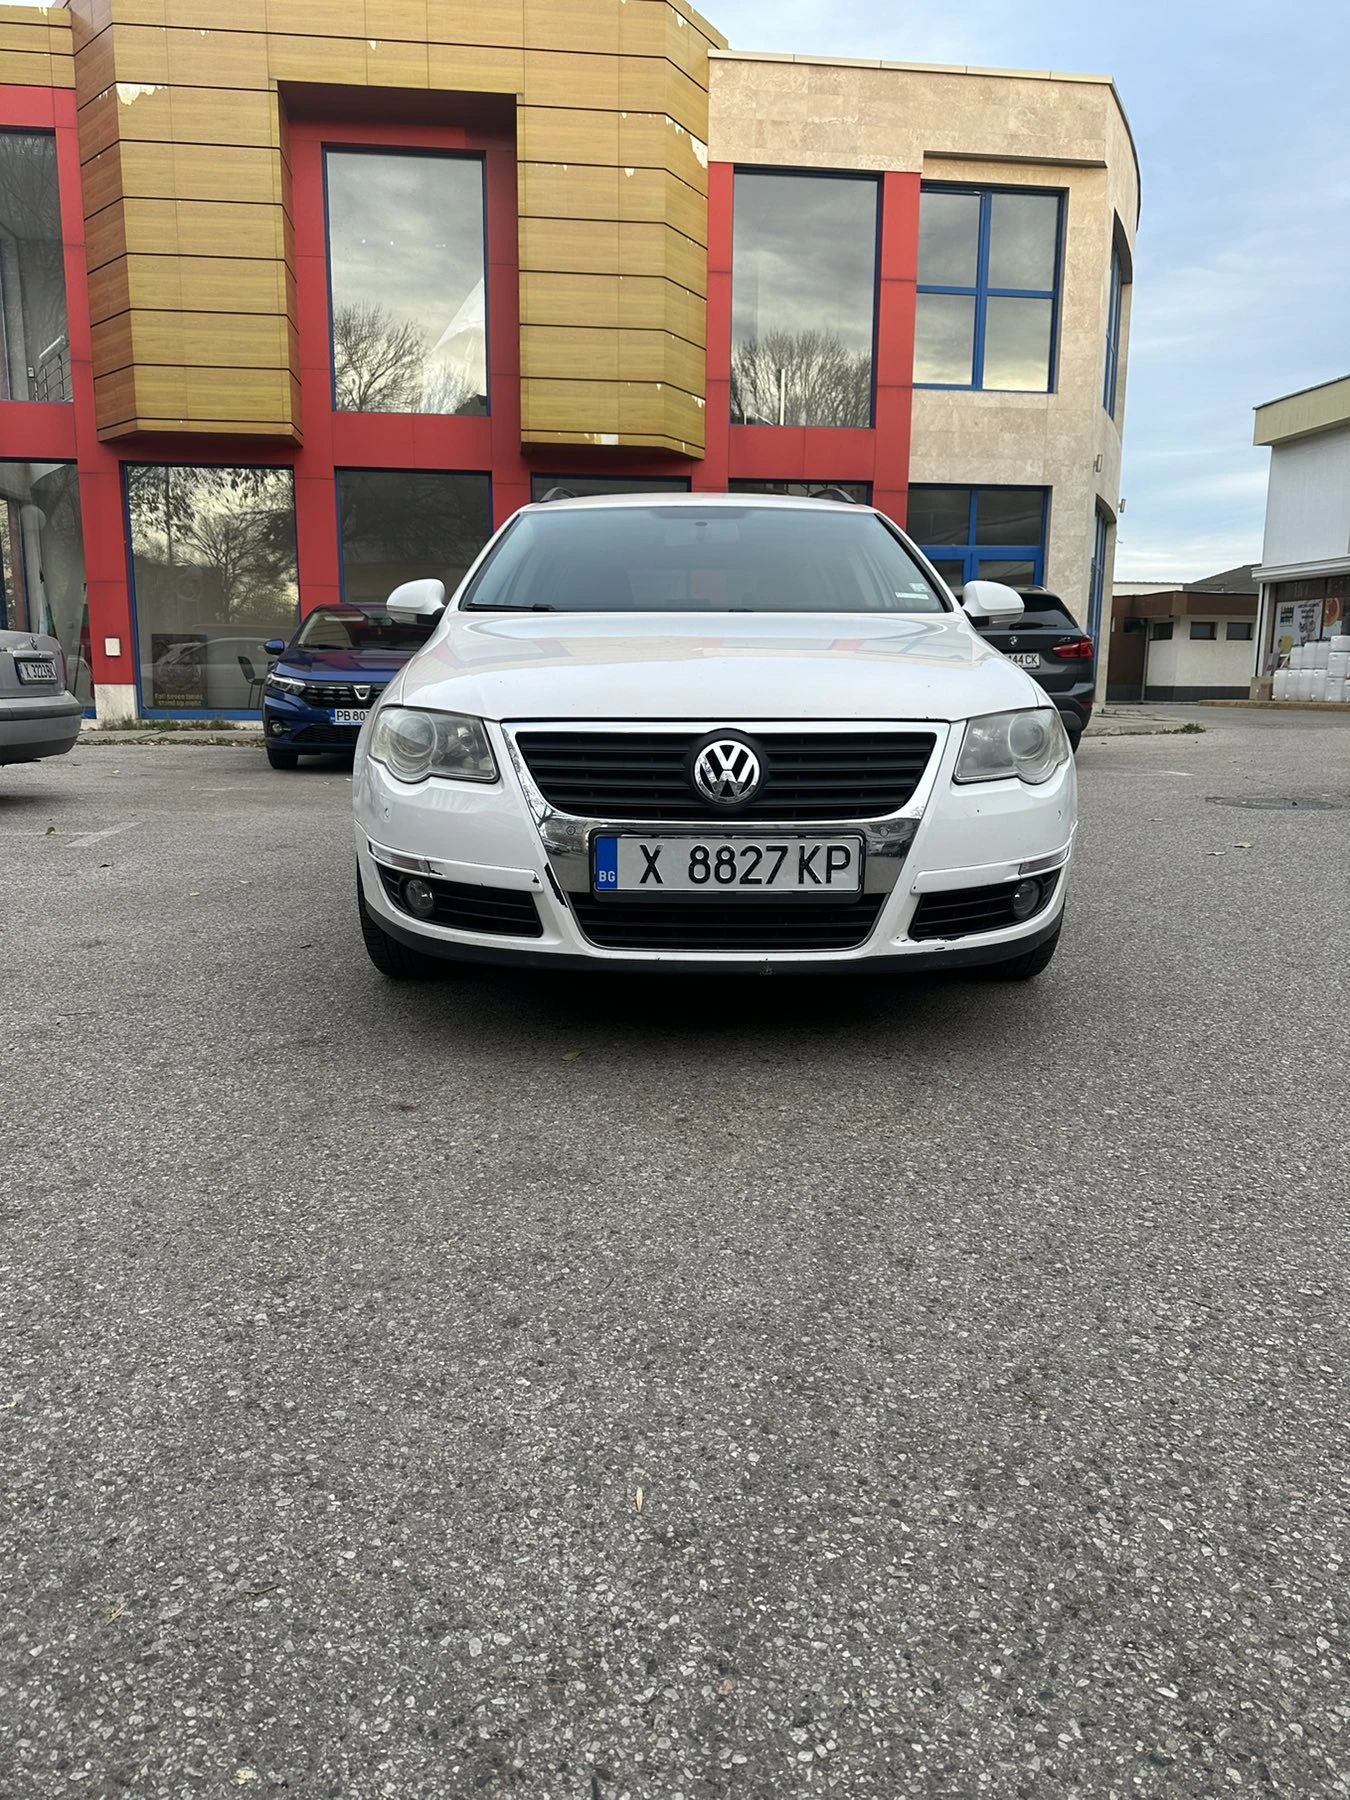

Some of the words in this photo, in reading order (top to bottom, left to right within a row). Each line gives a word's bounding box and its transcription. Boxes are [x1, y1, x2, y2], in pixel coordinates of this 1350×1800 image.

[1025, 655, 1037, 664] CK
[337, 710, 350, 721] PB
[639, 844, 664, 884] X
[599, 870, 616, 882] BG
